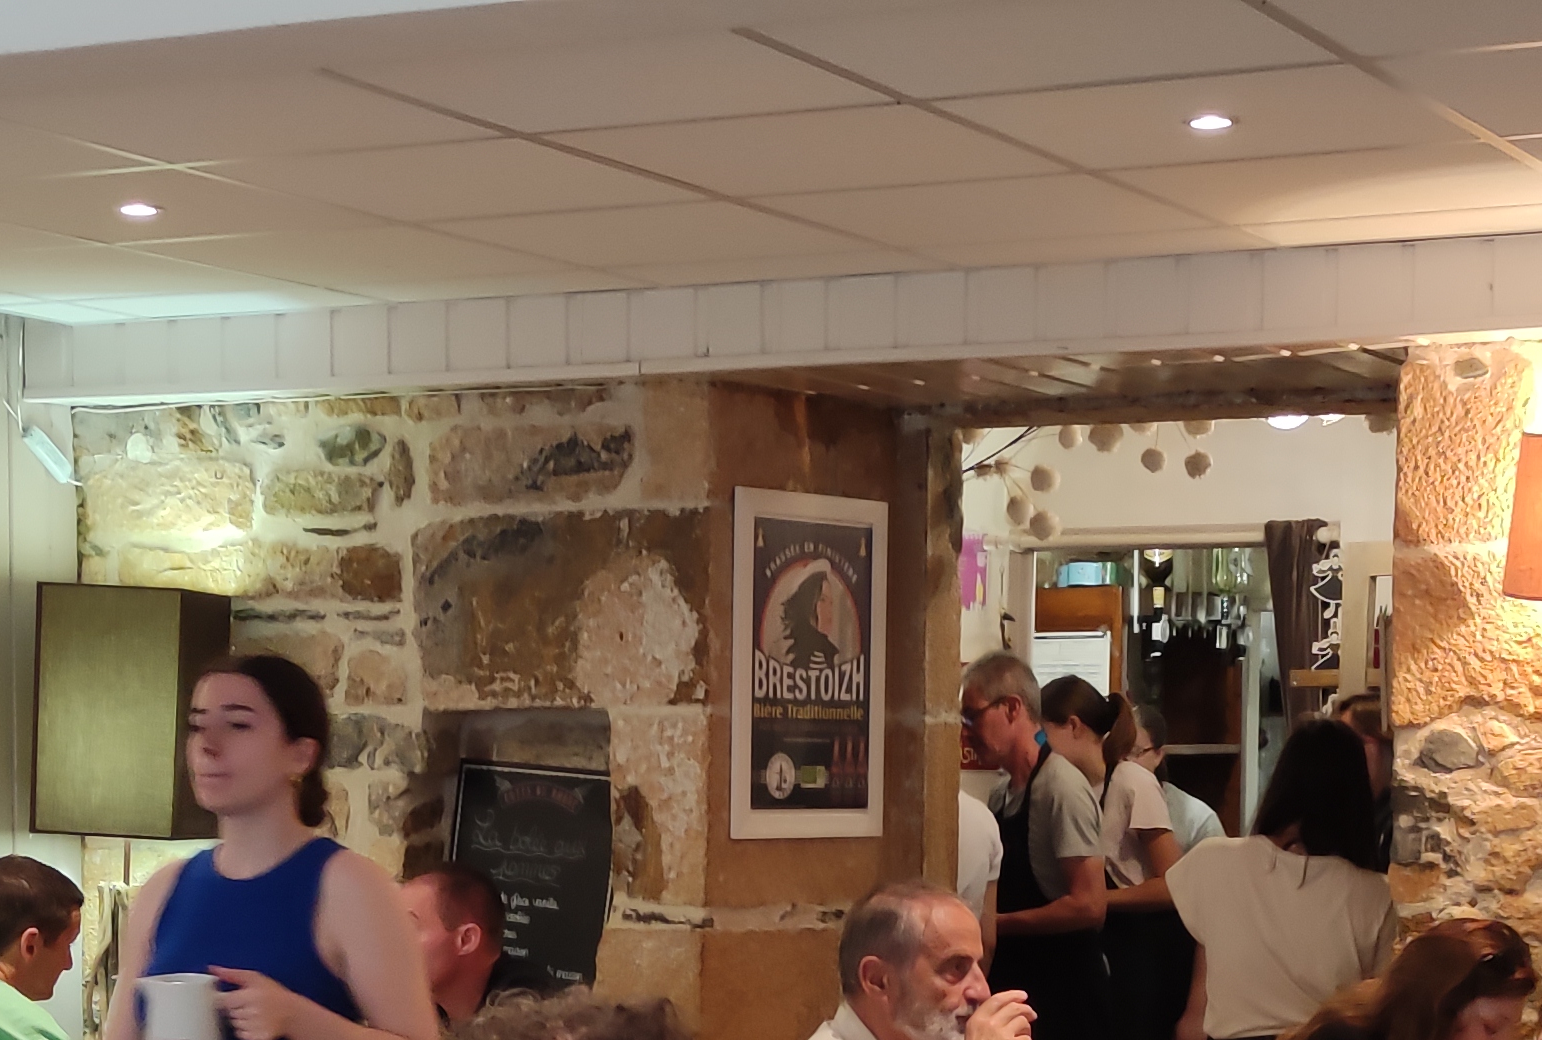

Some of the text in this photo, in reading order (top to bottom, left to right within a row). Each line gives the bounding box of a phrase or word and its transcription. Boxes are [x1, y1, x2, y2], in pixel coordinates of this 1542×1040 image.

[754, 648, 865, 702] BRESTOIZH
[753, 703, 865, 720] Bière Traditionnelle
